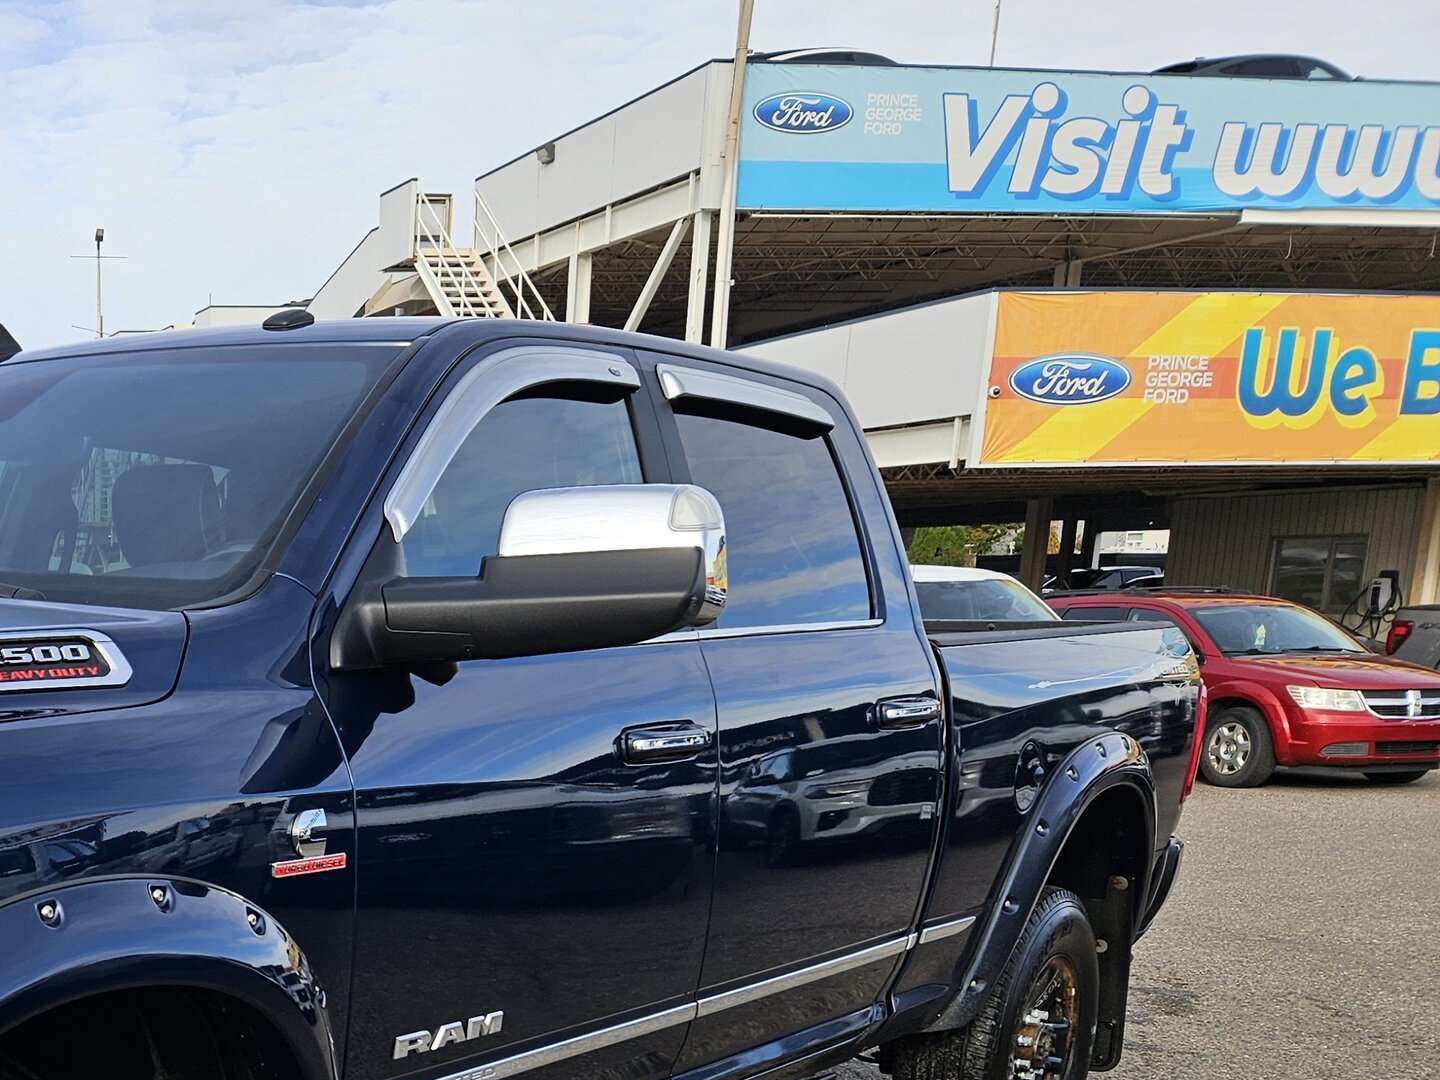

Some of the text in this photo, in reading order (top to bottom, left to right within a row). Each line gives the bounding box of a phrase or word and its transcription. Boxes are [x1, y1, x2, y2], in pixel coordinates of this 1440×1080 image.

[866, 93, 919, 107] PRINCE
[771, 96, 835, 128] Ford
[865, 108, 923, 122] GEORGE
[863, 122, 902, 136] FORD
[942, 81, 1440, 200] Visit ww
[1147, 356, 1209, 371] PRINCE
[1032, 360, 1109, 396] Ford
[1145, 371, 1214, 388] GEORGE
[1236, 326, 1378, 418] We
[1143, 388, 1189, 404] FORD
[49, 666, 99, 679] DUTY
[392, 1010, 504, 1060] RAM
